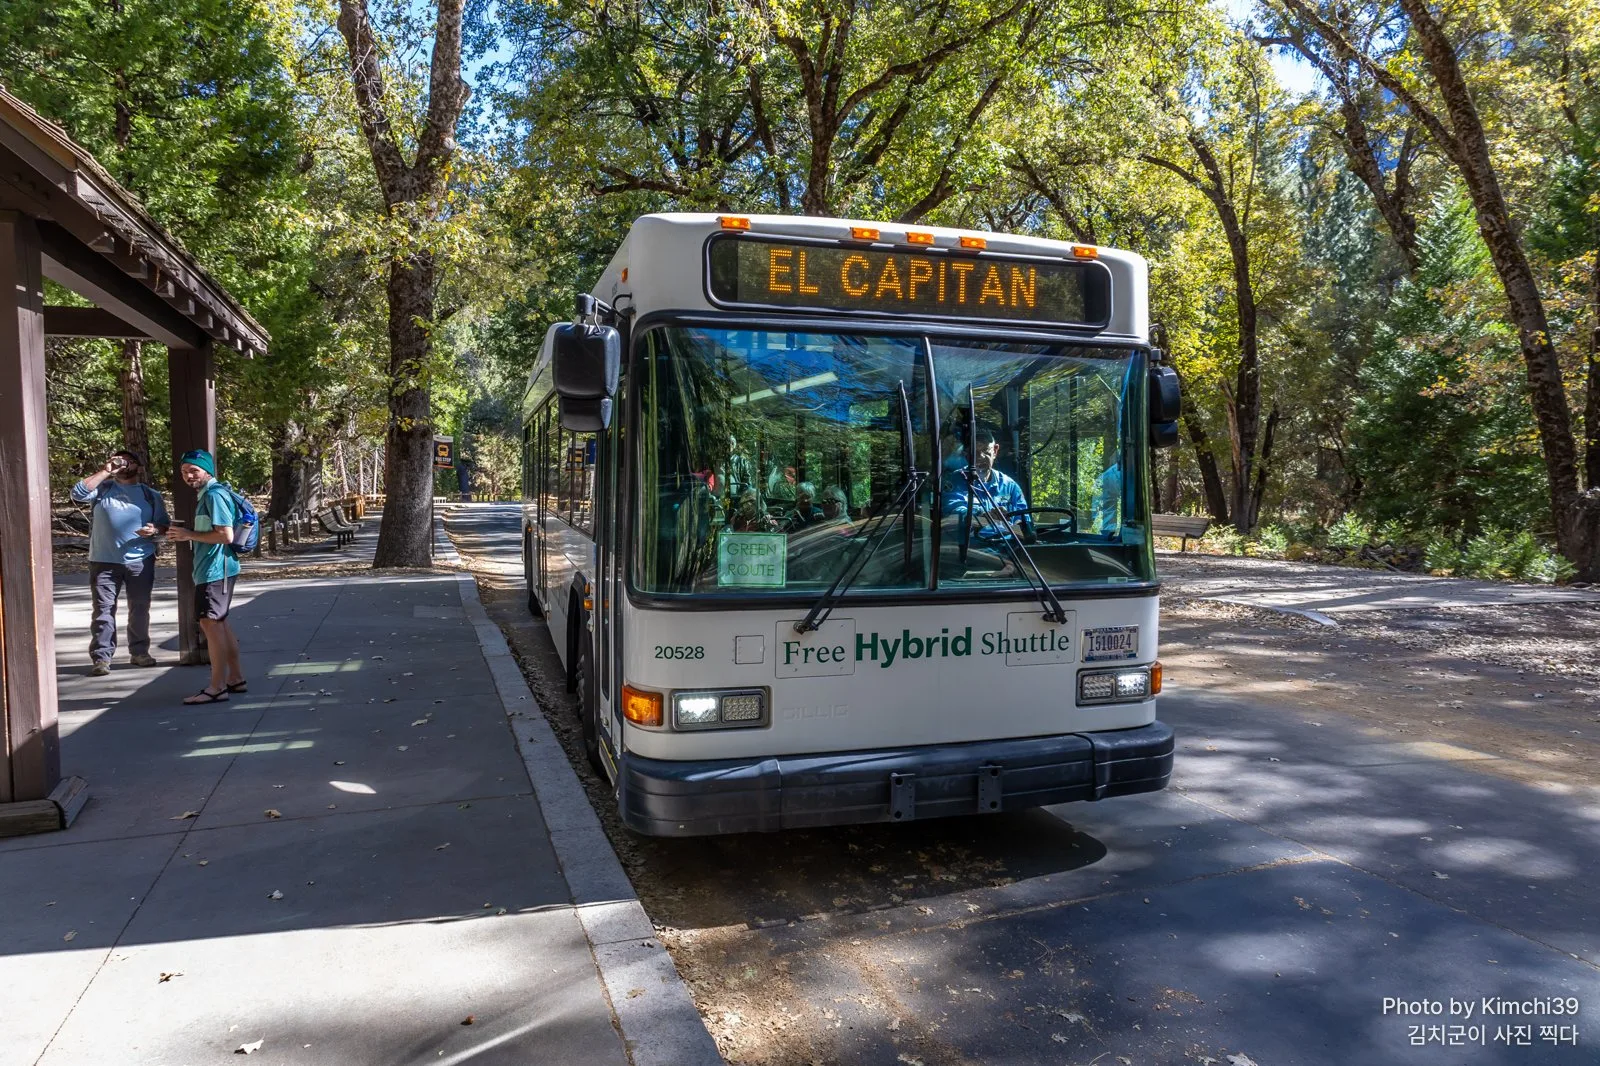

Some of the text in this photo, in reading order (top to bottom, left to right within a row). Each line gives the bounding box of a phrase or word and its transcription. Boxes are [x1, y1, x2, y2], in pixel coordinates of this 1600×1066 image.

[769, 248, 1037, 308] EL CAPITAN
[726, 542, 777, 556] GREEN
[727, 563, 775, 577] ROUTE
[783, 627, 1070, 668] Free Hybrid Shuttle
[1089, 633, 1132, 652] I510024
[654, 645, 705, 660] 20528
